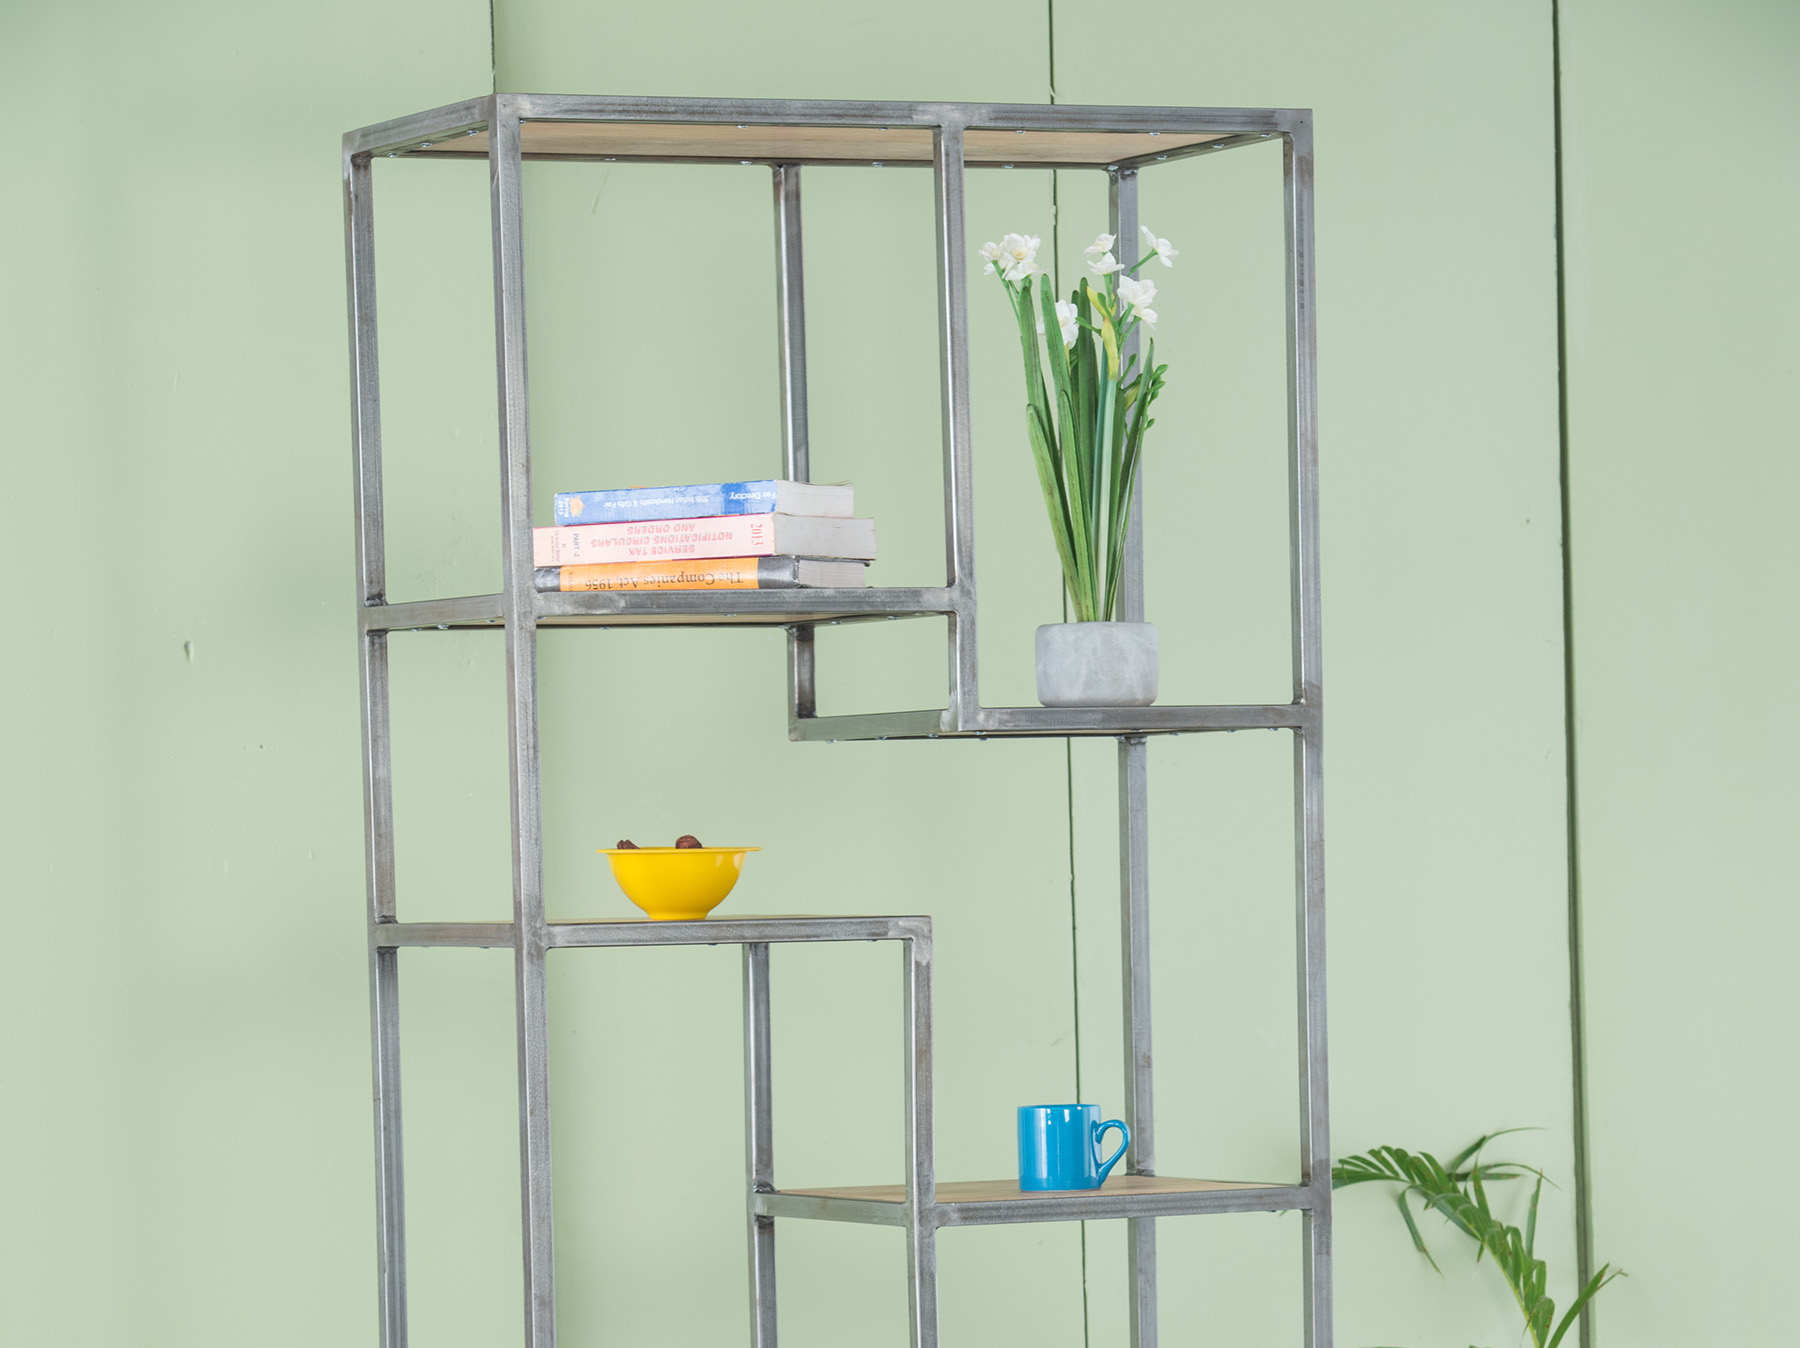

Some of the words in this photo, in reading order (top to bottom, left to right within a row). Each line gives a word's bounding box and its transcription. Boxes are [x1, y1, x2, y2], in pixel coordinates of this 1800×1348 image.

[730, 491, 761, 500] Directory
[762, 491, 776, 499] Fair
[617, 500, 632, 508] Gifts
[639, 498, 674, 506] Handicrafts
[627, 524, 670, 535] ORDERS
[674, 523, 696, 533] AND
[750, 523, 764, 546] 2013
[629, 547, 648, 556] TAX
[651, 544, 695, 555] SERVICE
[616, 576, 640, 588] Act,
[643, 571, 716, 588] Companies
[718, 572, 744, 584] The
[585, 578, 613, 591] 1956
